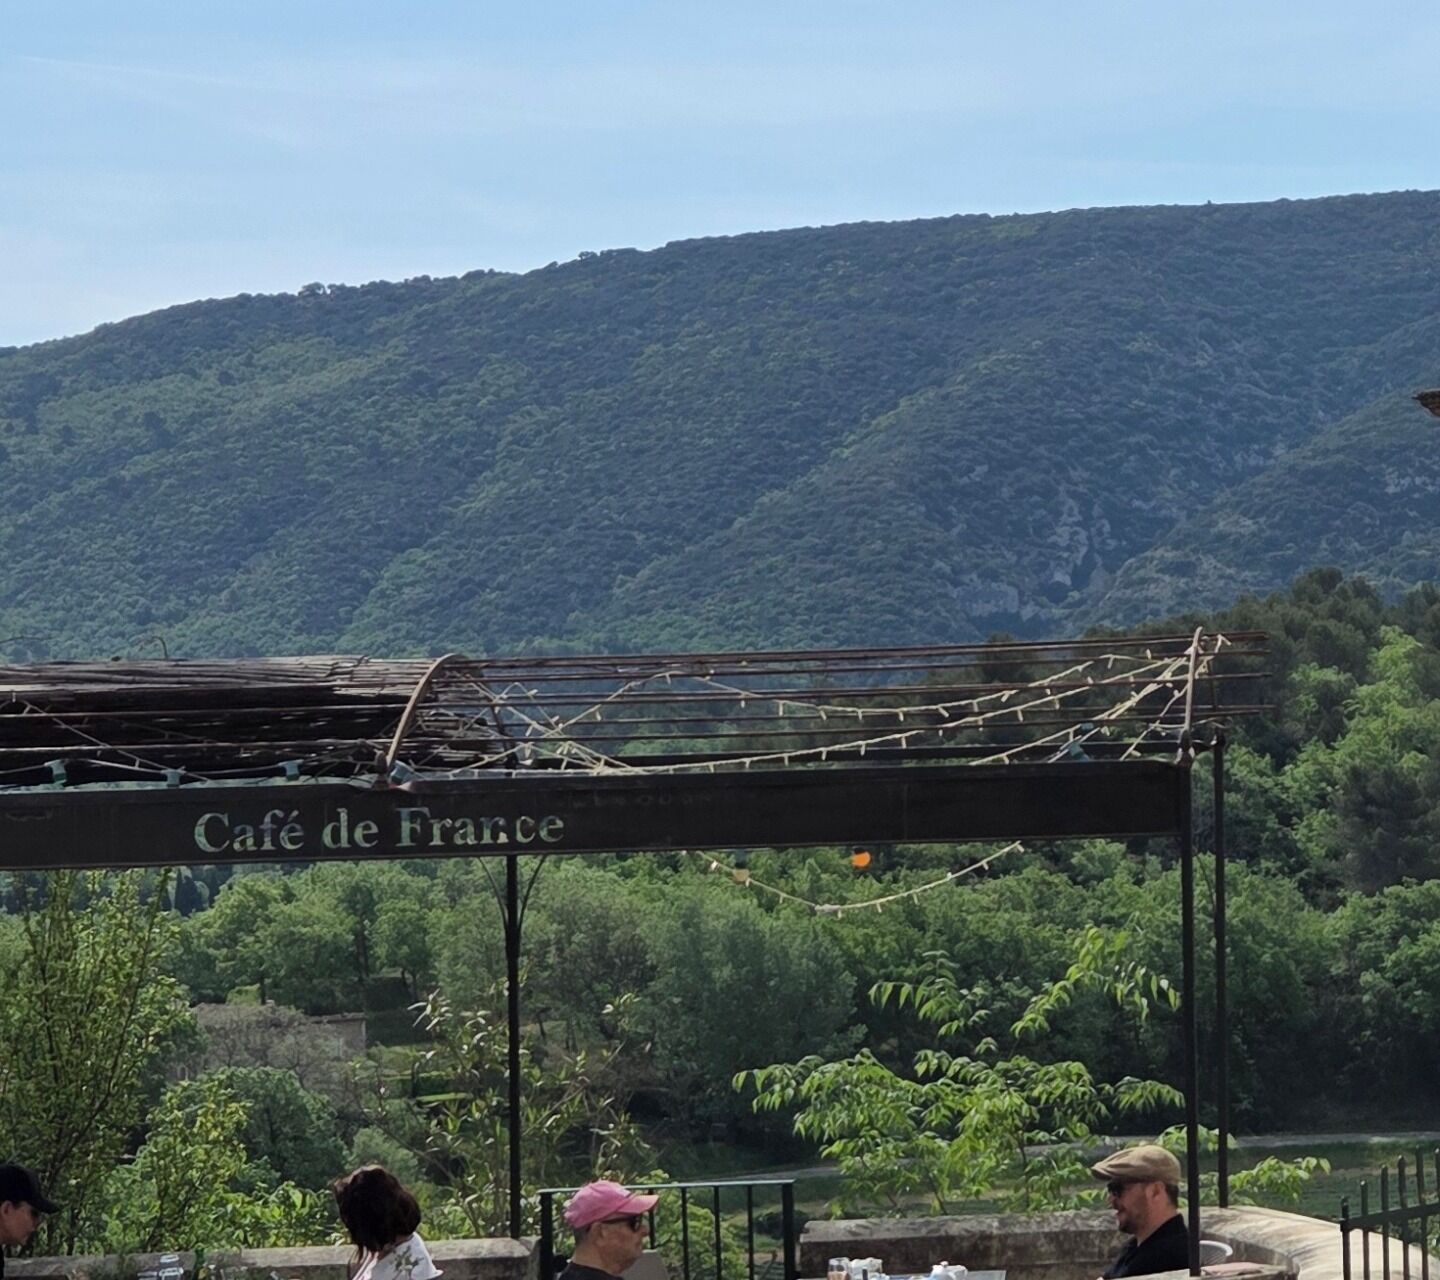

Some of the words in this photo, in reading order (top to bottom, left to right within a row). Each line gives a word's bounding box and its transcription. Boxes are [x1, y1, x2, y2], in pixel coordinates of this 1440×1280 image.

[194, 809, 305, 853] Café
[322, 808, 379, 849] de
[396, 806, 564, 848] France
